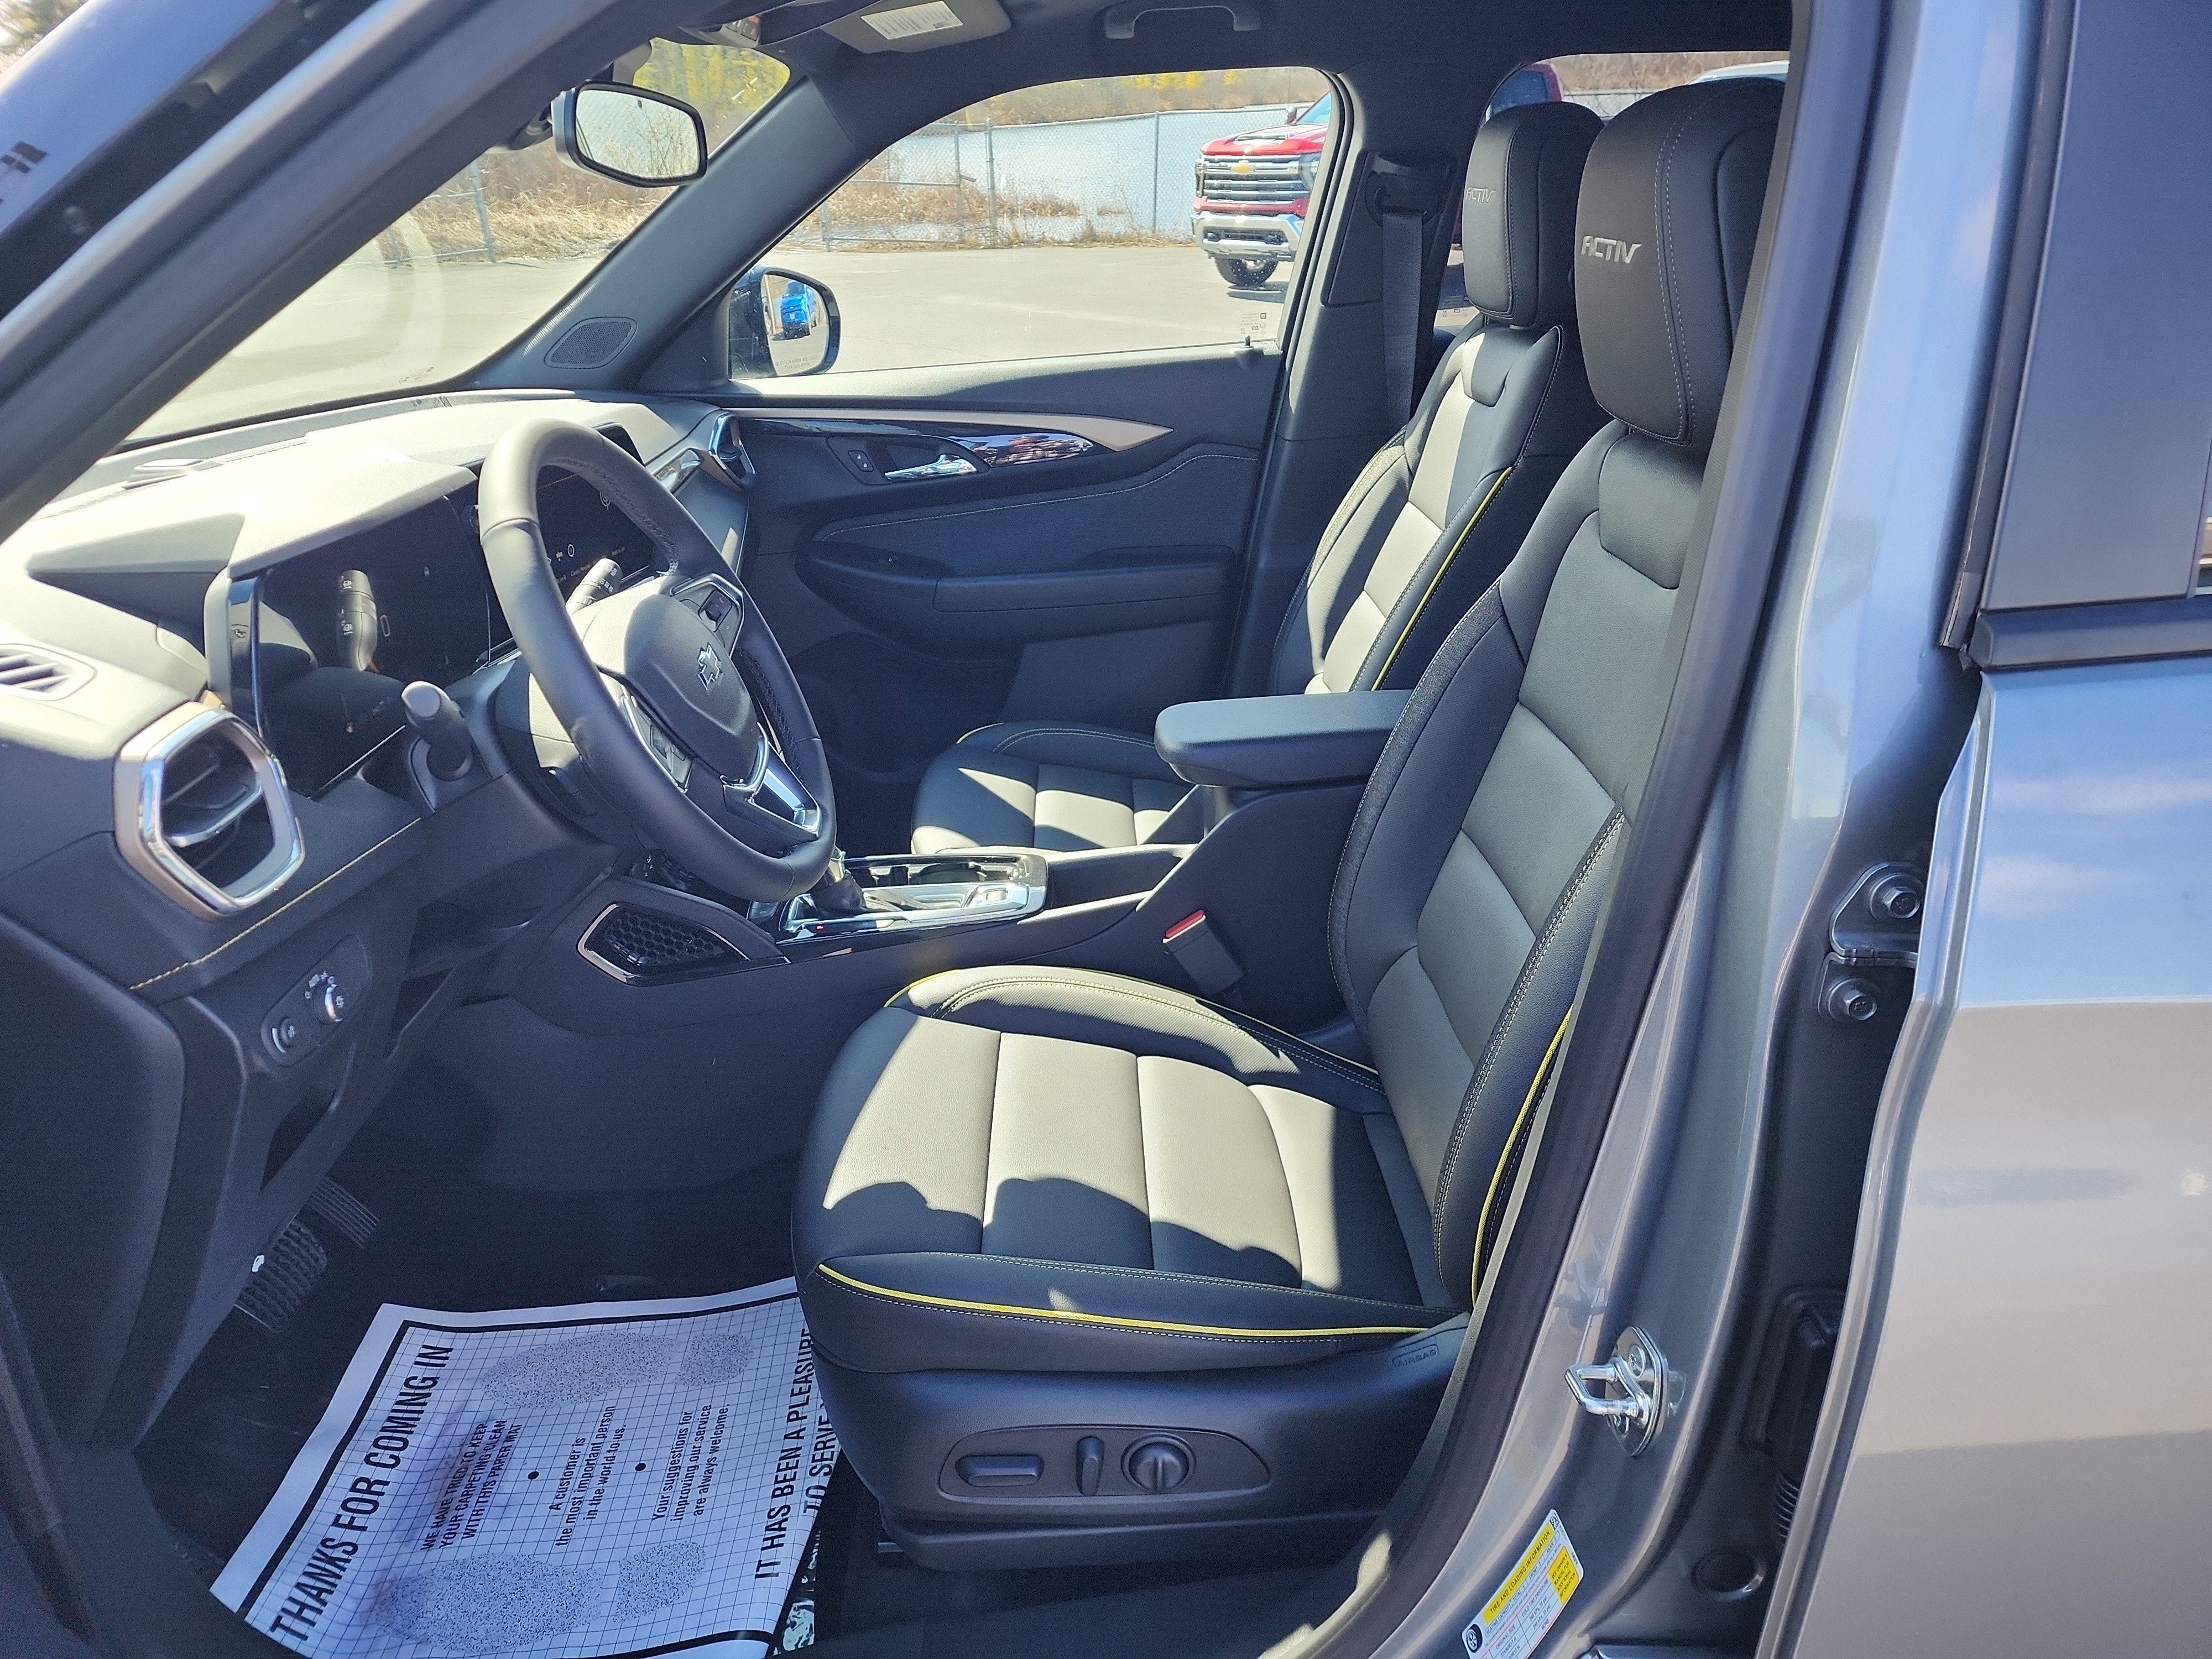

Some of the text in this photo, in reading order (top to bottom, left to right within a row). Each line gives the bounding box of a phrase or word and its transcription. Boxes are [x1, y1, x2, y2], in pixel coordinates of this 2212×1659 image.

[1465, 186, 1496, 203] ACTIV
[1581, 236, 1642, 264] ACTIV
[1397, 1349, 1437, 1366] AIRBAG
[555, 1450, 582, 1500] customer
[572, 1438, 586, 1448] is
[583, 1424, 627, 1520] in the world to us.
[651, 1411, 693, 1521] Your suggestions for
[670, 1405, 712, 1521] improving our service
[693, 1404, 729, 1516] are always welcome.
[771, 1446, 802, 1499] BEEN
[783, 1427, 807, 1440] A
[270, 1344, 455, 1641] THANKS FOR COMING IN
[420, 1423, 488, 1551] WE HAVE TRIED TO KEEP
[439, 1420, 507, 1549] YOUR CARPETING CLEAN
[461, 1423, 523, 1540] WITH THIS PAPER MAT
[555, 1406, 615, 1547] the most important person
[803, 1485, 827, 1513] TO
[754, 1559, 781, 1579] IT
[760, 1504, 791, 1552] HAS
[1490, 1599, 1500, 1614] TIRE
[1499, 1588, 1509, 1603] AND
[1508, 1565, 1526, 1591] LOADING
[1525, 1529, 1550, 1567] INFORMATION
